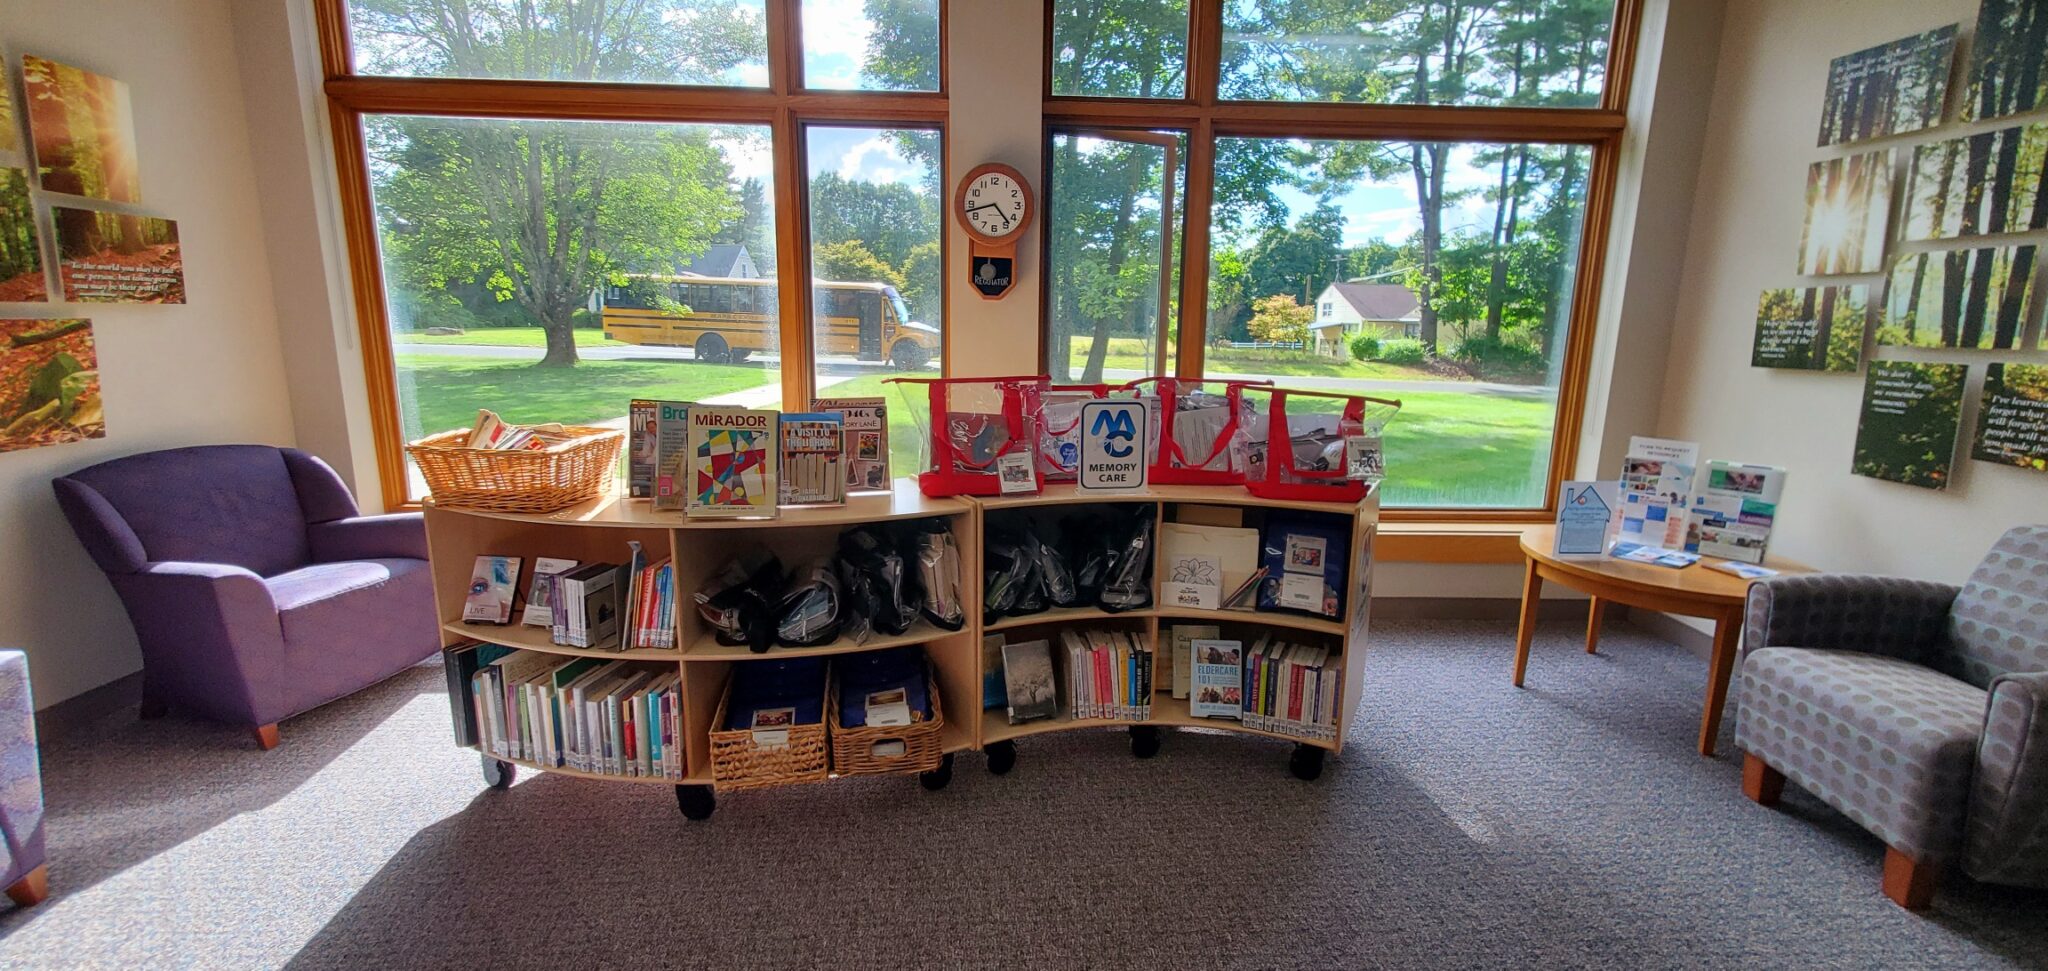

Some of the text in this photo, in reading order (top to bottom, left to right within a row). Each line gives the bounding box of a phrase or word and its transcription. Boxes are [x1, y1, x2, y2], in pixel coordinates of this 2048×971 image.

[980, 181, 987, 189] 11
[990, 177, 1000, 186] 12
[972, 189, 980, 197] 10
[1011, 190, 1018, 198] 2
[968, 200, 975, 208] 9
[1014, 202, 1021, 210] 3
[972, 212, 979, 221] 8
[1010, 213, 1017, 221] 4
[981, 221, 987, 229] 7
[991, 225, 998, 233] 6
[1002, 221, 1009, 230] 5
[84, 262, 96, 270] the
[97, 263, 120, 271] world
[120, 265, 134, 273] you
[1875, 380, 1914, 388] remember
[1885, 390, 1925, 399] remember
[1992, 395, 2010, 404] I've
[1989, 405, 2045, 418] forget what
[859, 420, 877, 428] LANE
[1988, 418, 2007, 426] will
[790, 428, 831, 437] A VISIT TO
[1983, 428, 2016, 439] people
[2018, 432, 2039, 441] will
[786, 438, 836, 447] THE LIBRARY
[1983, 440, 2001, 448] you
[2003, 441, 2030, 451] made
[1089, 463, 1137, 472] MEMORY
[1099, 473, 1127, 482] CARE
[469, 607, 486, 615] LIVE
[1198, 665, 1238, 676] ELDERCARE
[1199, 676, 1211, 685] 101
